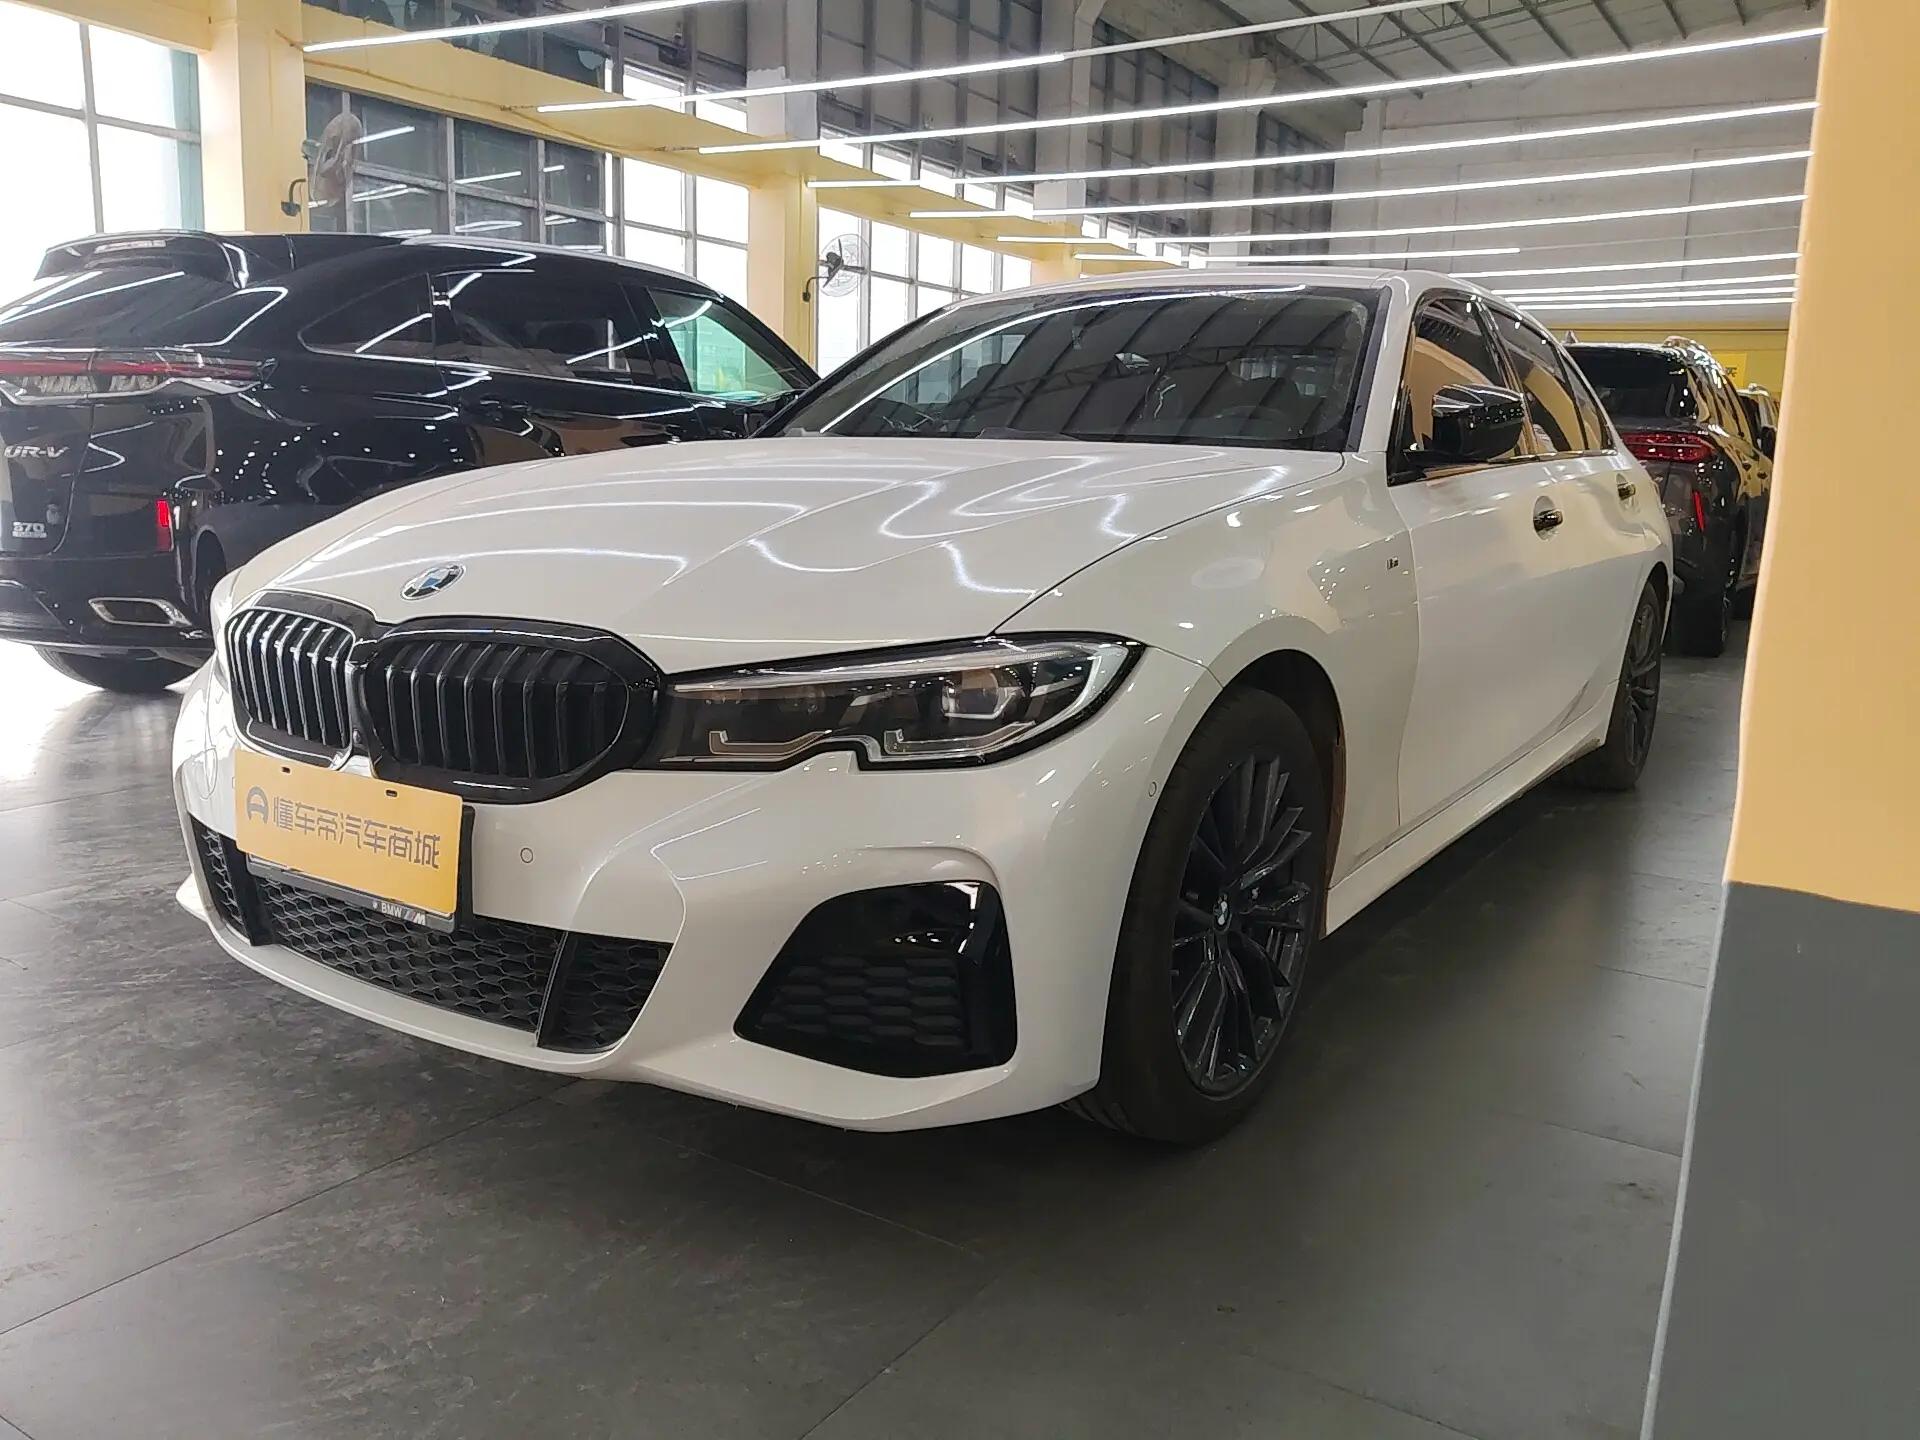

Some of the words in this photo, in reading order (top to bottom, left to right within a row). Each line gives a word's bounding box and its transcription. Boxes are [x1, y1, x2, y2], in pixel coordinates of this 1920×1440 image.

[4, 445, 70, 459] UR-V
[273, 796, 441, 869] 懂车帝汽车商城
[381, 902, 402, 918] BMW
